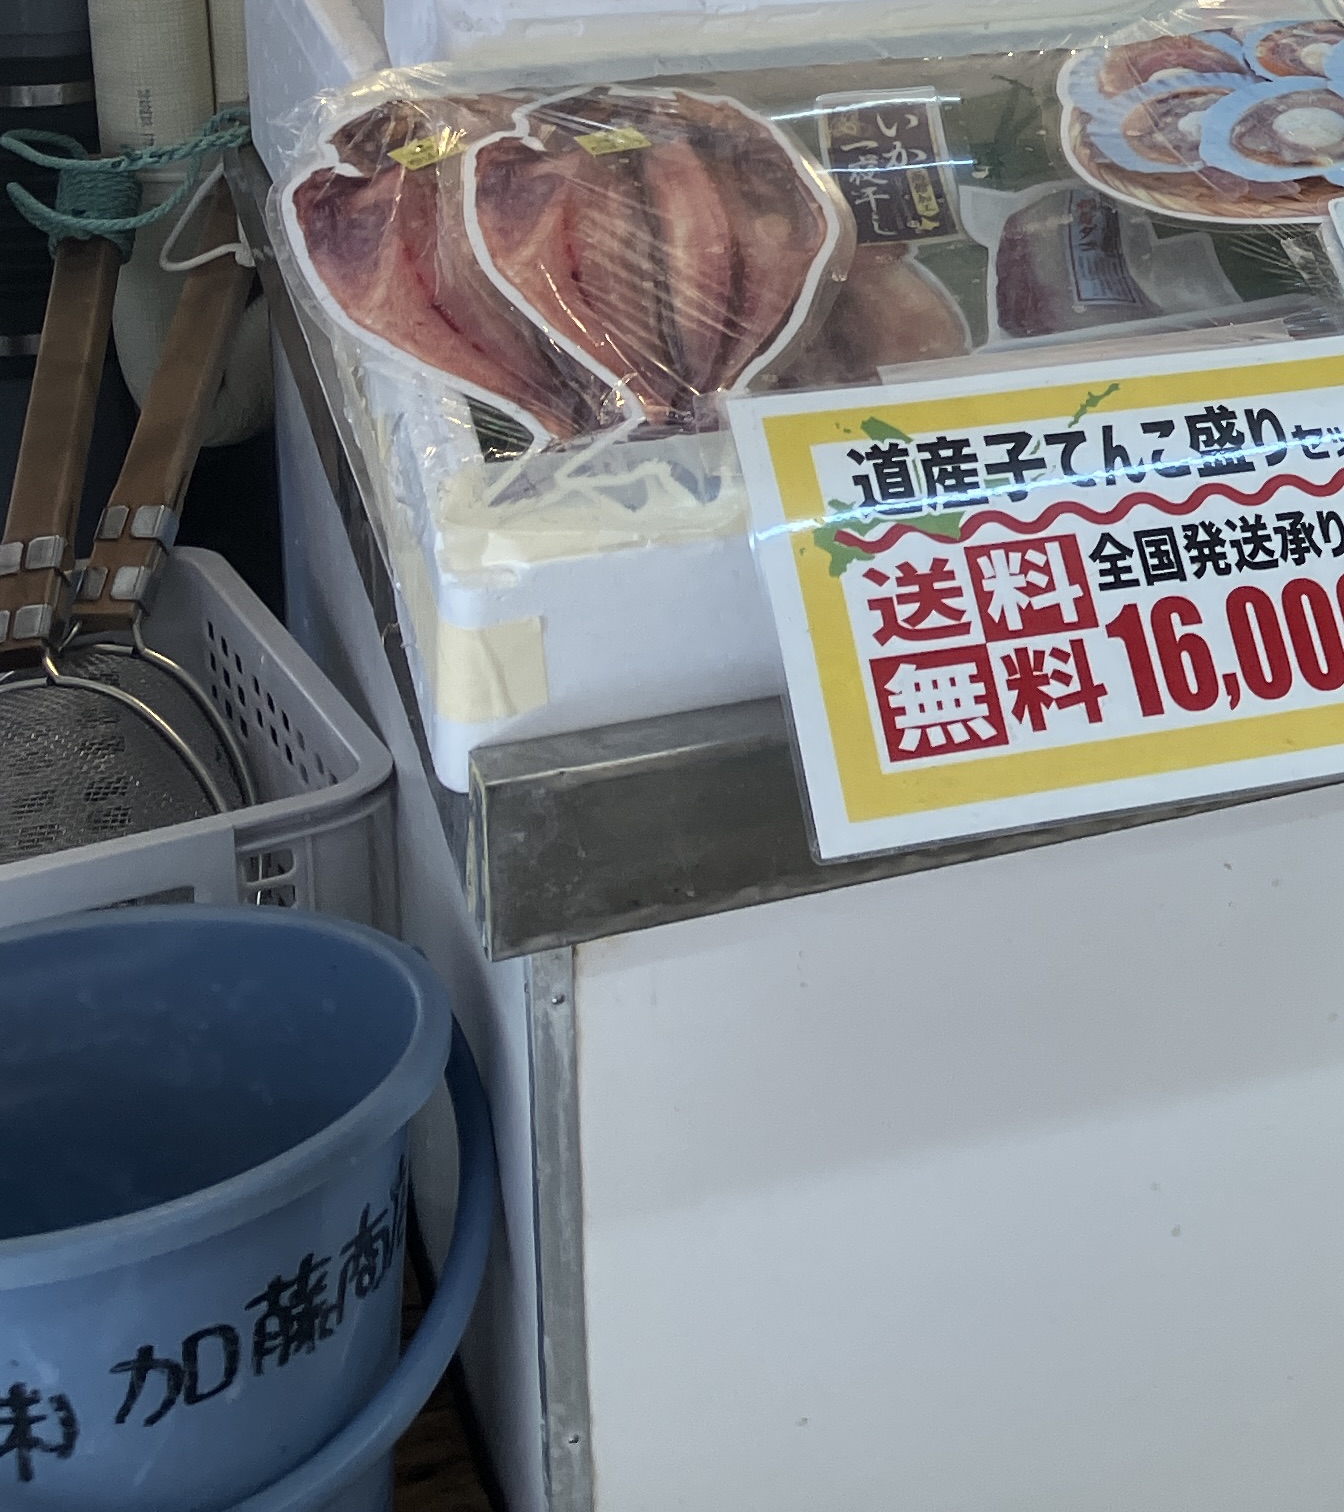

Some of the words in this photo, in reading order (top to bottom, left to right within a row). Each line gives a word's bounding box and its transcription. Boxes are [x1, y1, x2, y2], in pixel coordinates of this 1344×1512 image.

[840, 140, 898, 236] 一夜干し
[876, 112, 927, 169] いか
[867, 536, 1094, 647] 送料
[880, 636, 1109, 758] 無料
[110, 1178, 406, 1427] 加藤商
